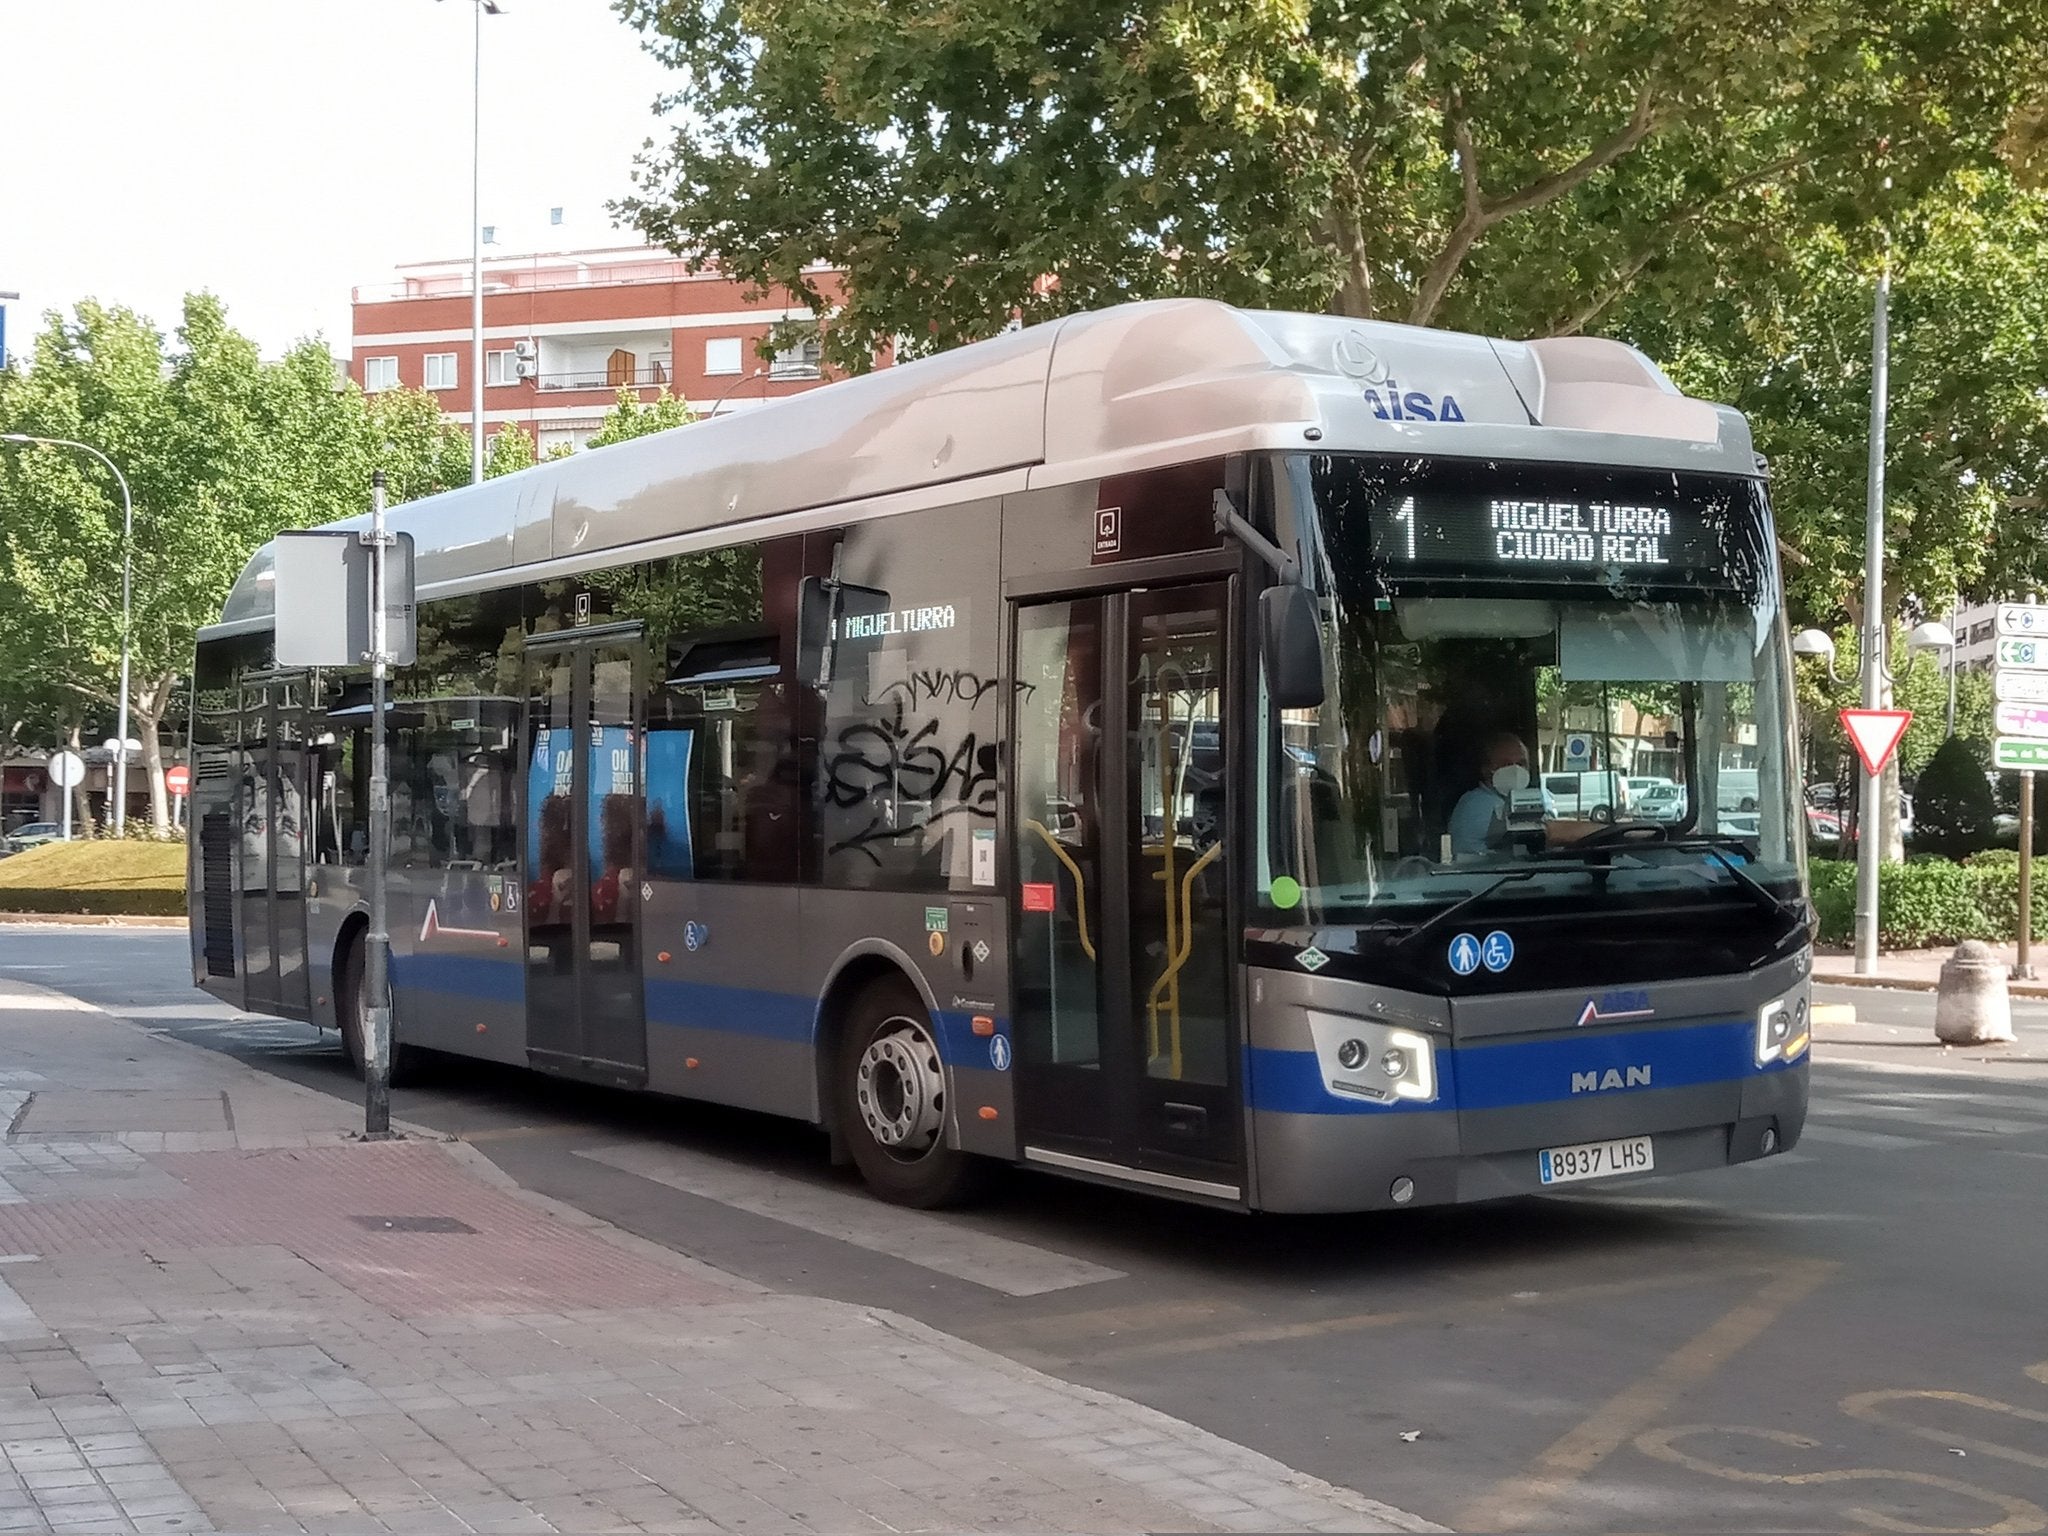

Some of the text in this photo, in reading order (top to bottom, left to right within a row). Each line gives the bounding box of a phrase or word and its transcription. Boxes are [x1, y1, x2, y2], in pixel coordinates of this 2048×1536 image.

[1396, 496, 1671, 559] 1 MIGUELTURRA
[1496, 530, 1670, 564] CIUDAD REAL
[845, 604, 956, 639] MIGUELTURRA
[1571, 1064, 1652, 1094] MAN
[1553, 1142, 1647, 1177] 8937 LHS
